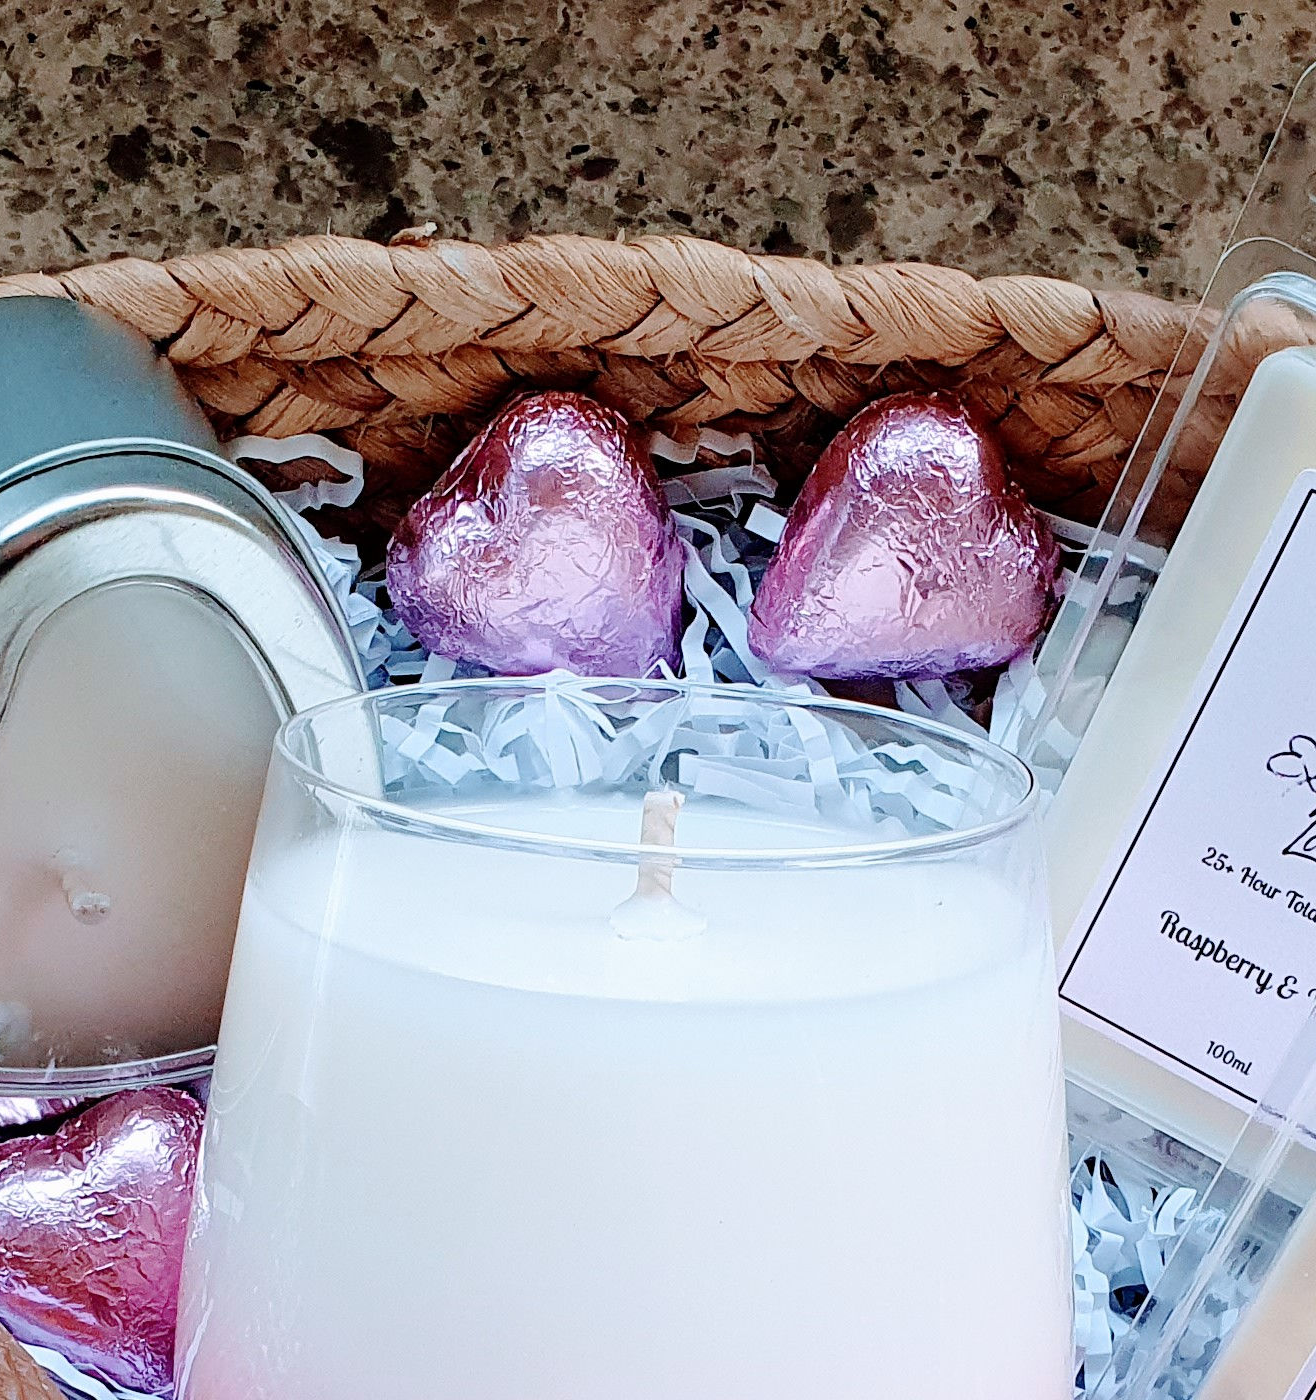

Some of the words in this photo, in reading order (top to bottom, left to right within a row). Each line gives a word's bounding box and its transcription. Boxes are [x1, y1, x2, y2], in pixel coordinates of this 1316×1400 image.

[1202, 847, 1234, 874] 25+
[1241, 867, 1281, 900] Hour
[1160, 910, 1273, 994] Raspberry
[1277, 976, 1299, 999] &
[1206, 1041, 1252, 1075] 100ml
